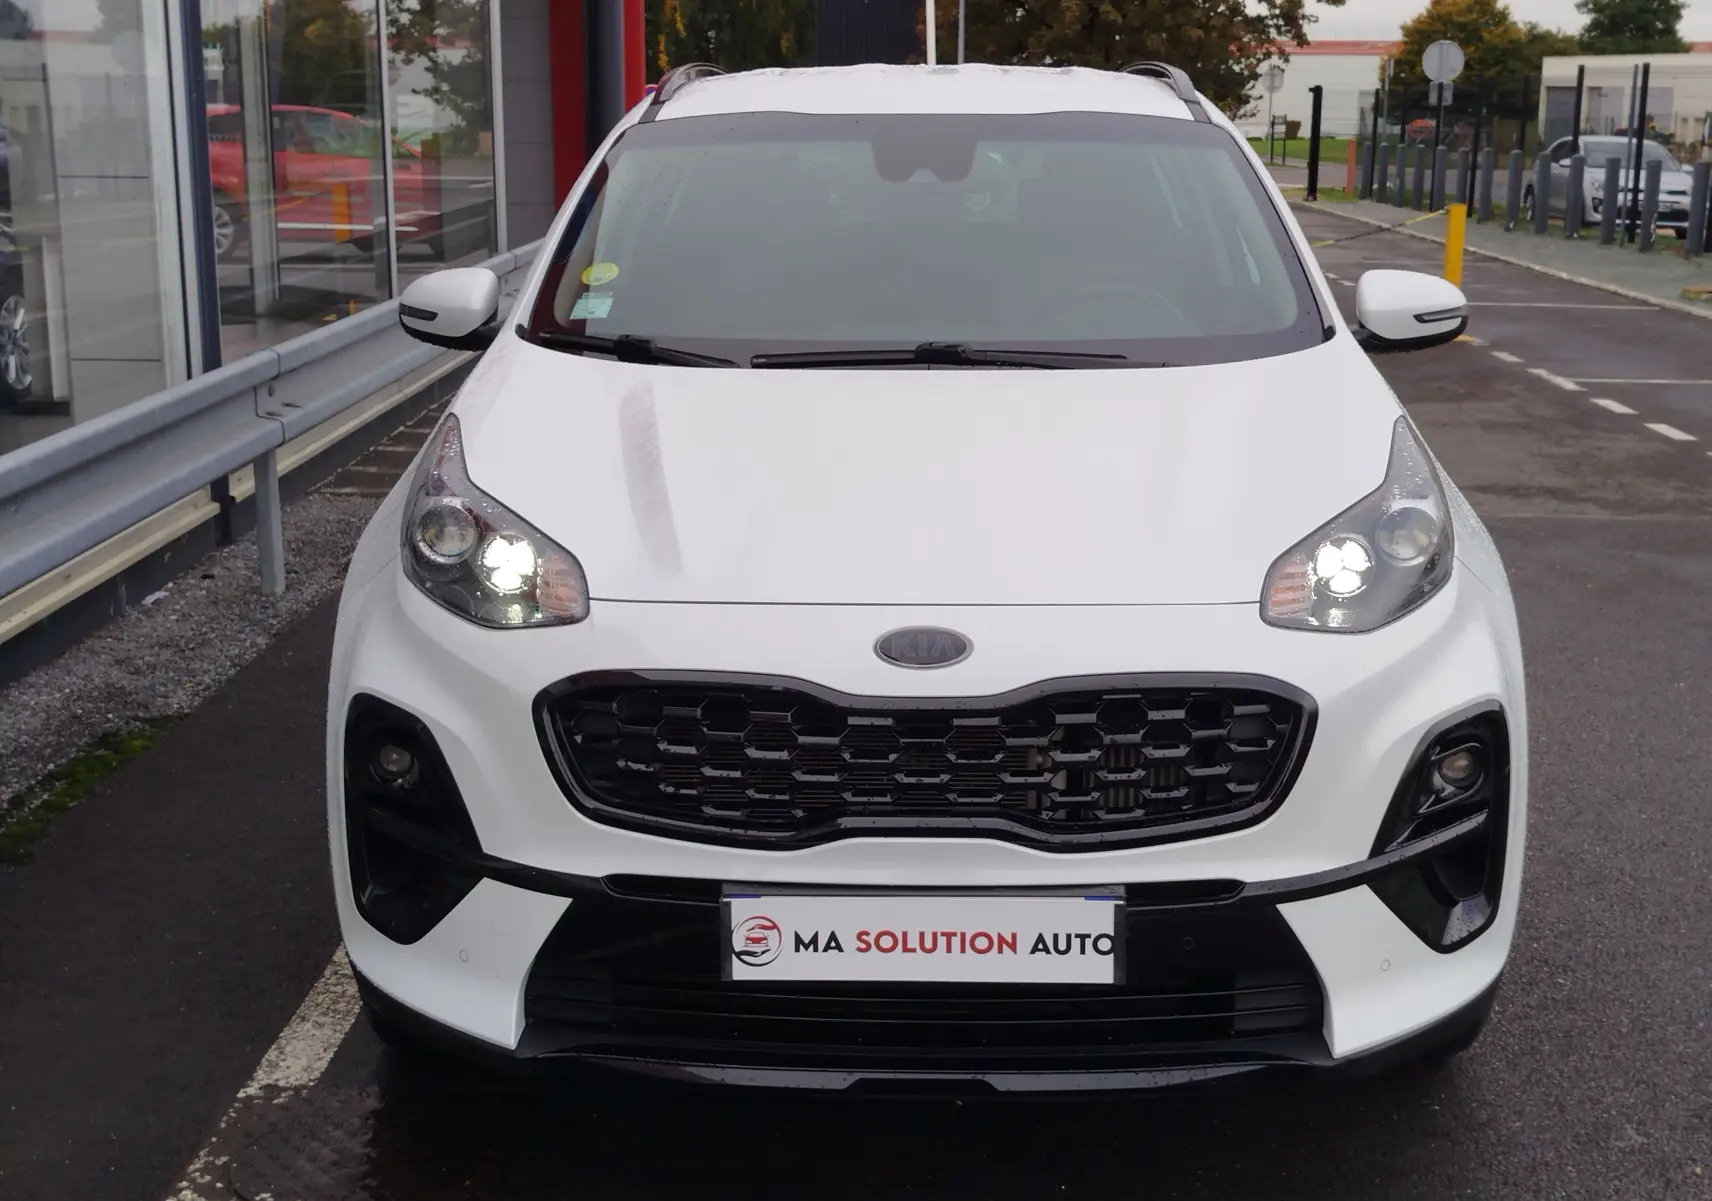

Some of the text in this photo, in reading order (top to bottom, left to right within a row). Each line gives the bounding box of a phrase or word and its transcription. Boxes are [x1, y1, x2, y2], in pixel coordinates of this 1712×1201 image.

[891, 633, 957, 657] KIA
[794, 930, 1115, 956] MA SOLUTION AUTO
